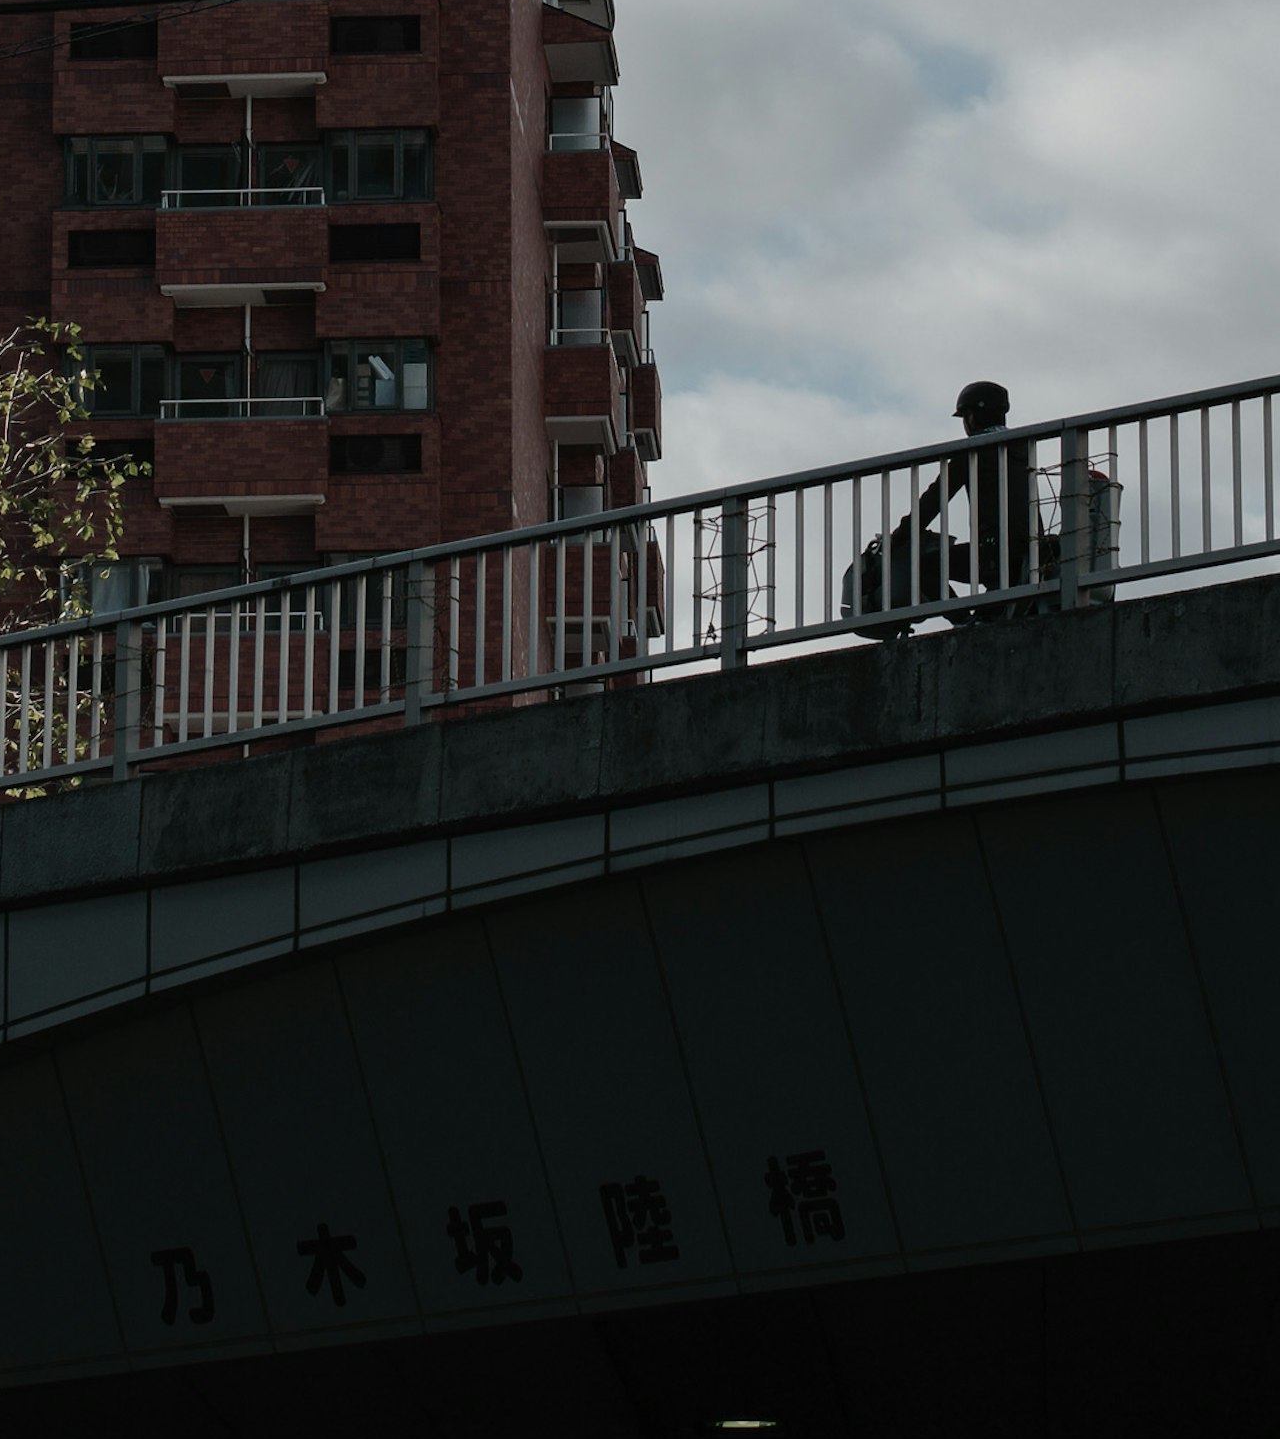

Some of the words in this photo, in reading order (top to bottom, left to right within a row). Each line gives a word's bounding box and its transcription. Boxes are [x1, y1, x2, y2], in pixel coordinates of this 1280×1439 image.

[149, 1149, 846, 1324] 乃木坂陸橋
